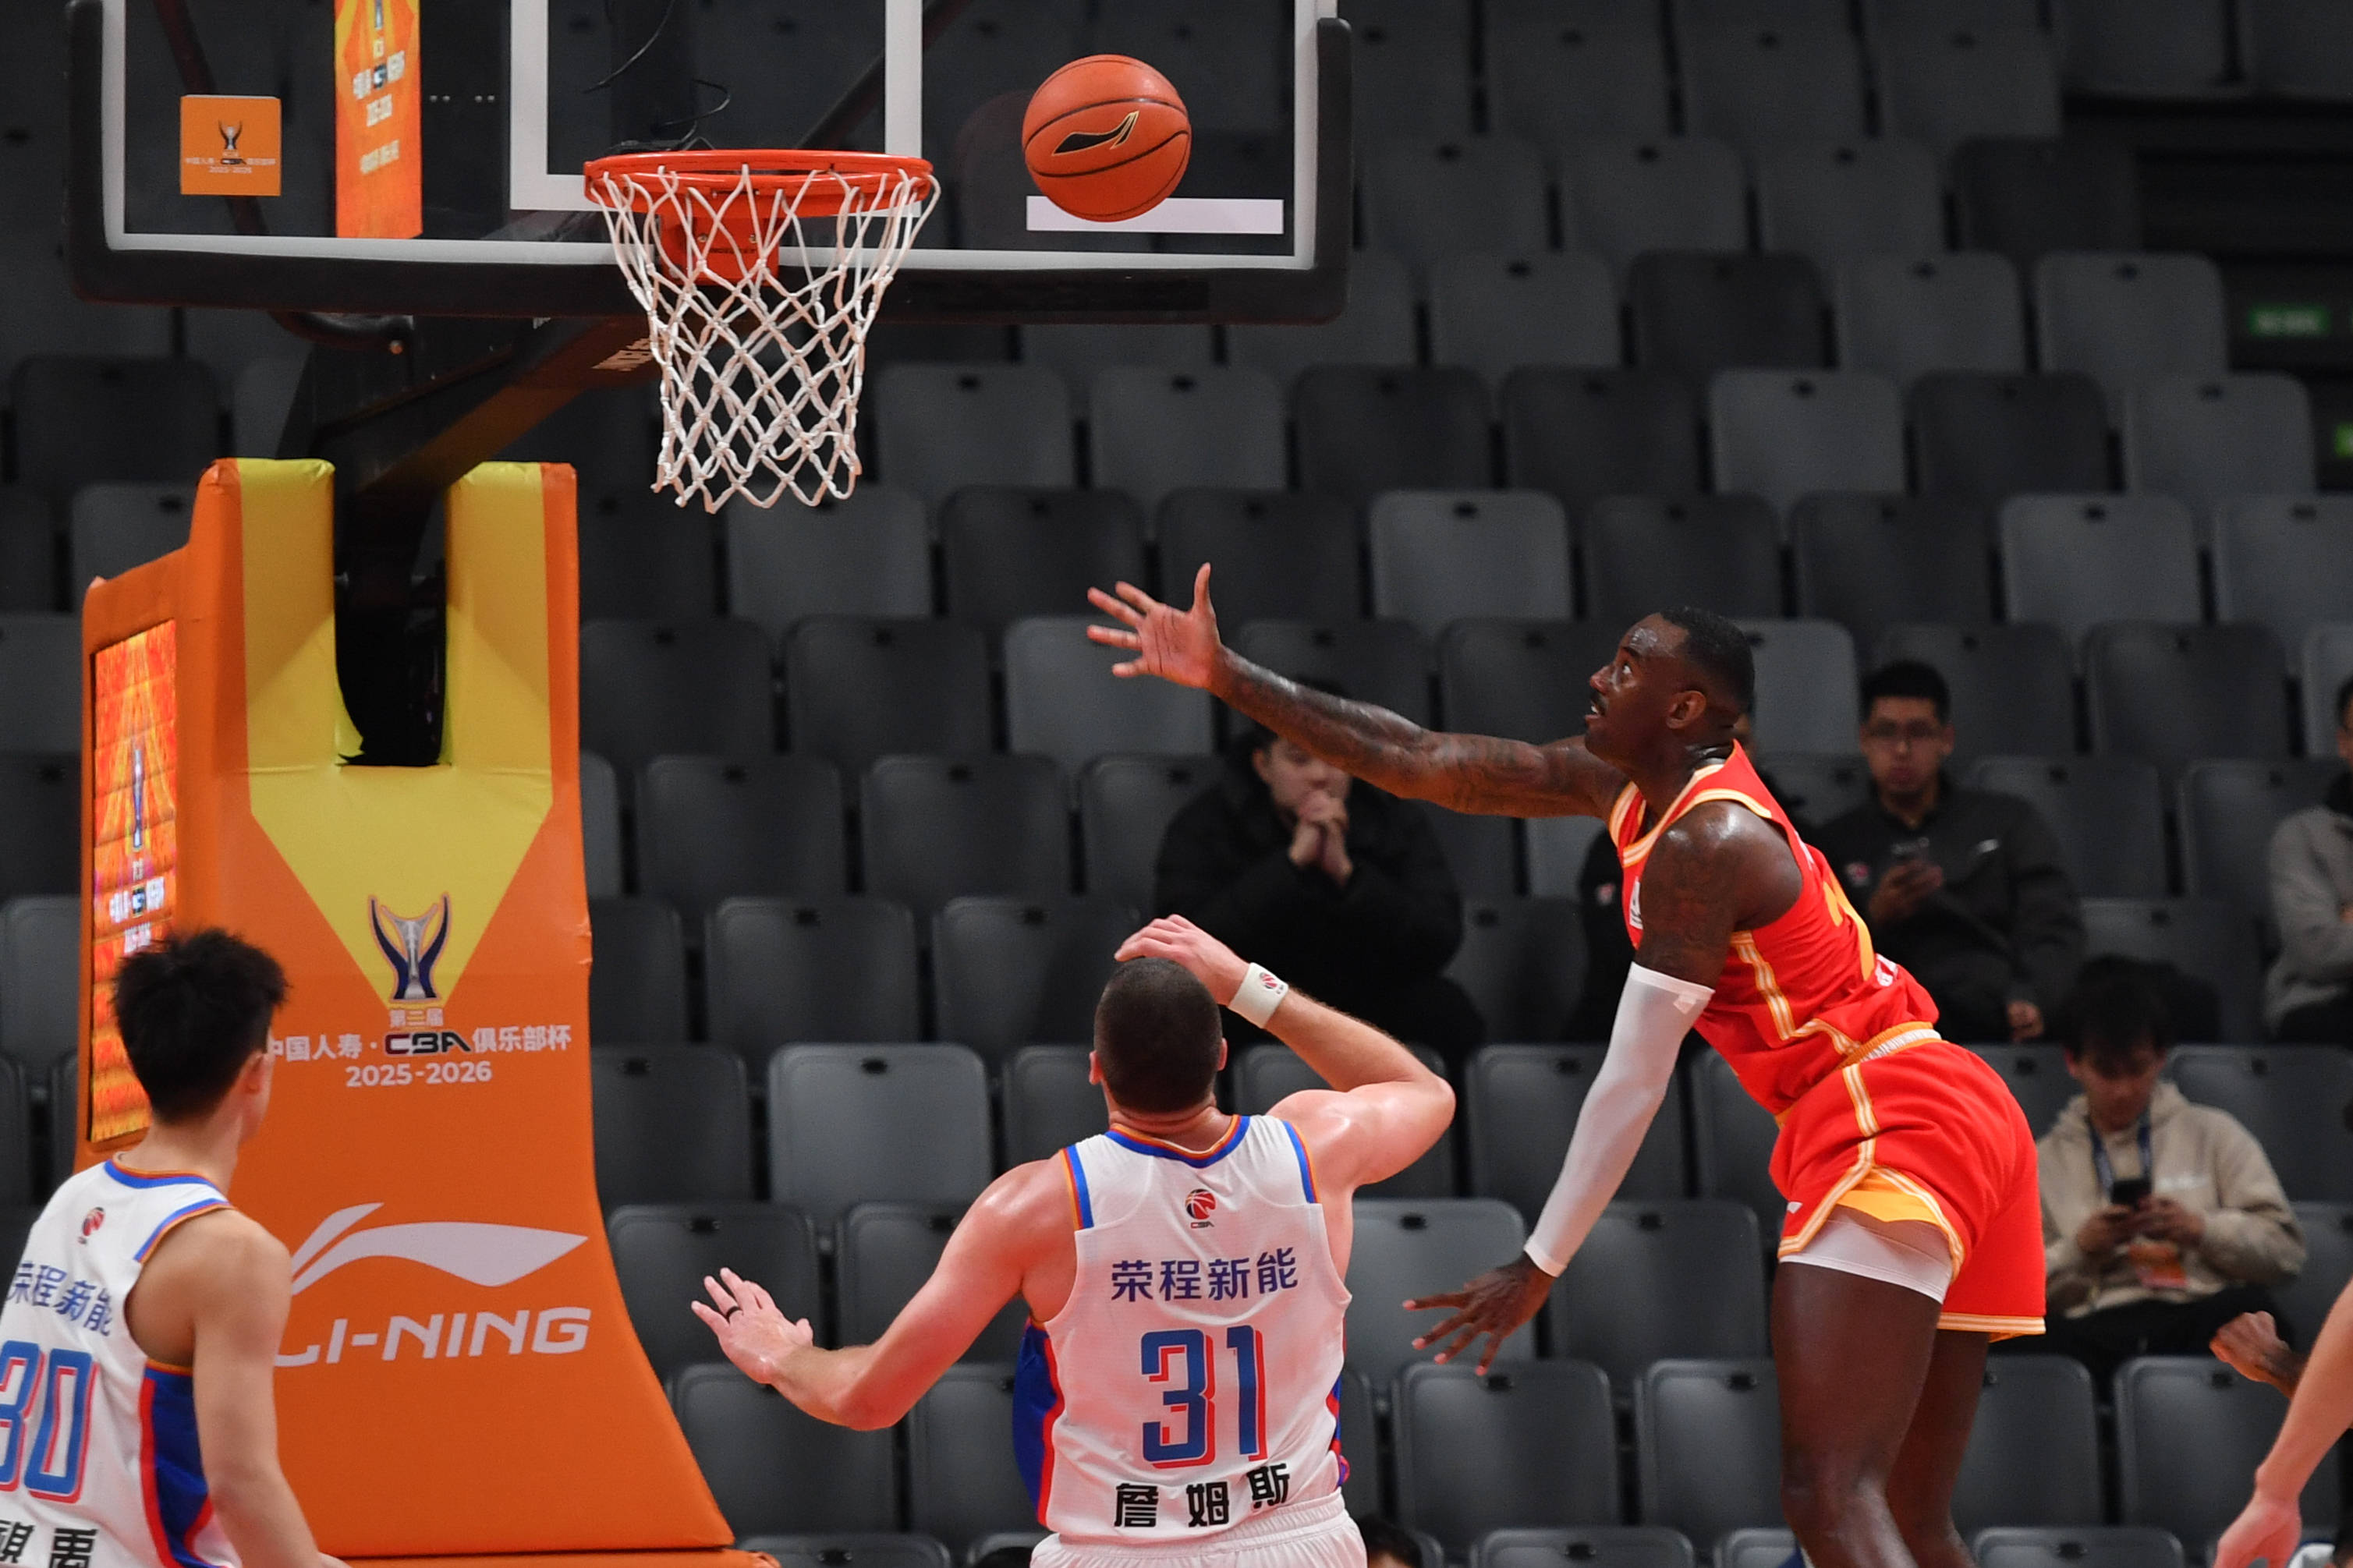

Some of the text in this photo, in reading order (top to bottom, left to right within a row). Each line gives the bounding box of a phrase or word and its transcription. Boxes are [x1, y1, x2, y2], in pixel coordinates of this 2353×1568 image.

[346, 1060, 493, 1087] 2025-2026
[1111, 1247, 1298, 1302] 荣程新能
[0, 1340, 100, 1504] 30
[1141, 1325, 1268, 1469] 31
[1114, 1463, 1290, 1528] 詹姆斯
